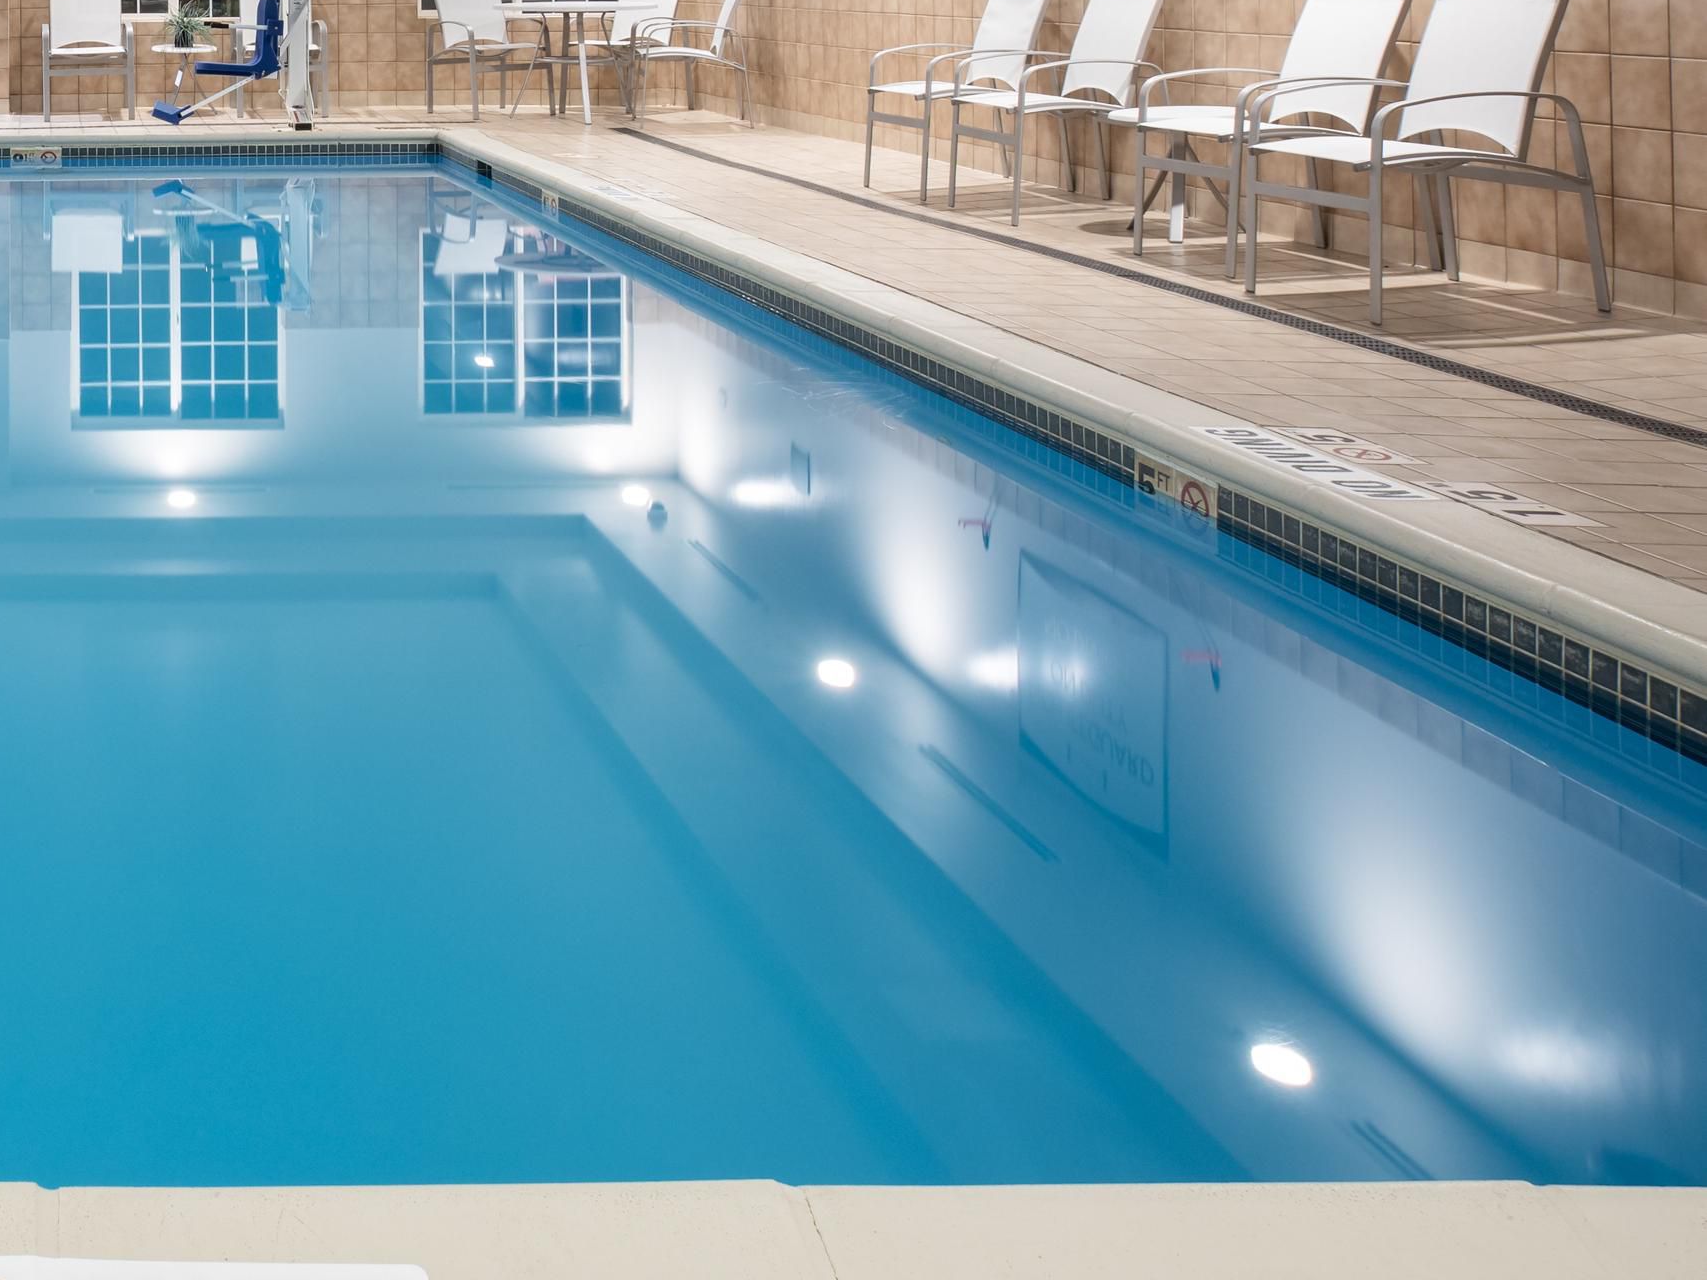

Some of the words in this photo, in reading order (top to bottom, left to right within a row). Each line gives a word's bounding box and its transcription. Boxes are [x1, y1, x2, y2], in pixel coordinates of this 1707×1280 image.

[1205, 428, 1354, 473] DIVING
[1138, 462, 1156, 495] 5
[1157, 471, 1170, 492] FT
[1331, 479, 1425, 499] NO
